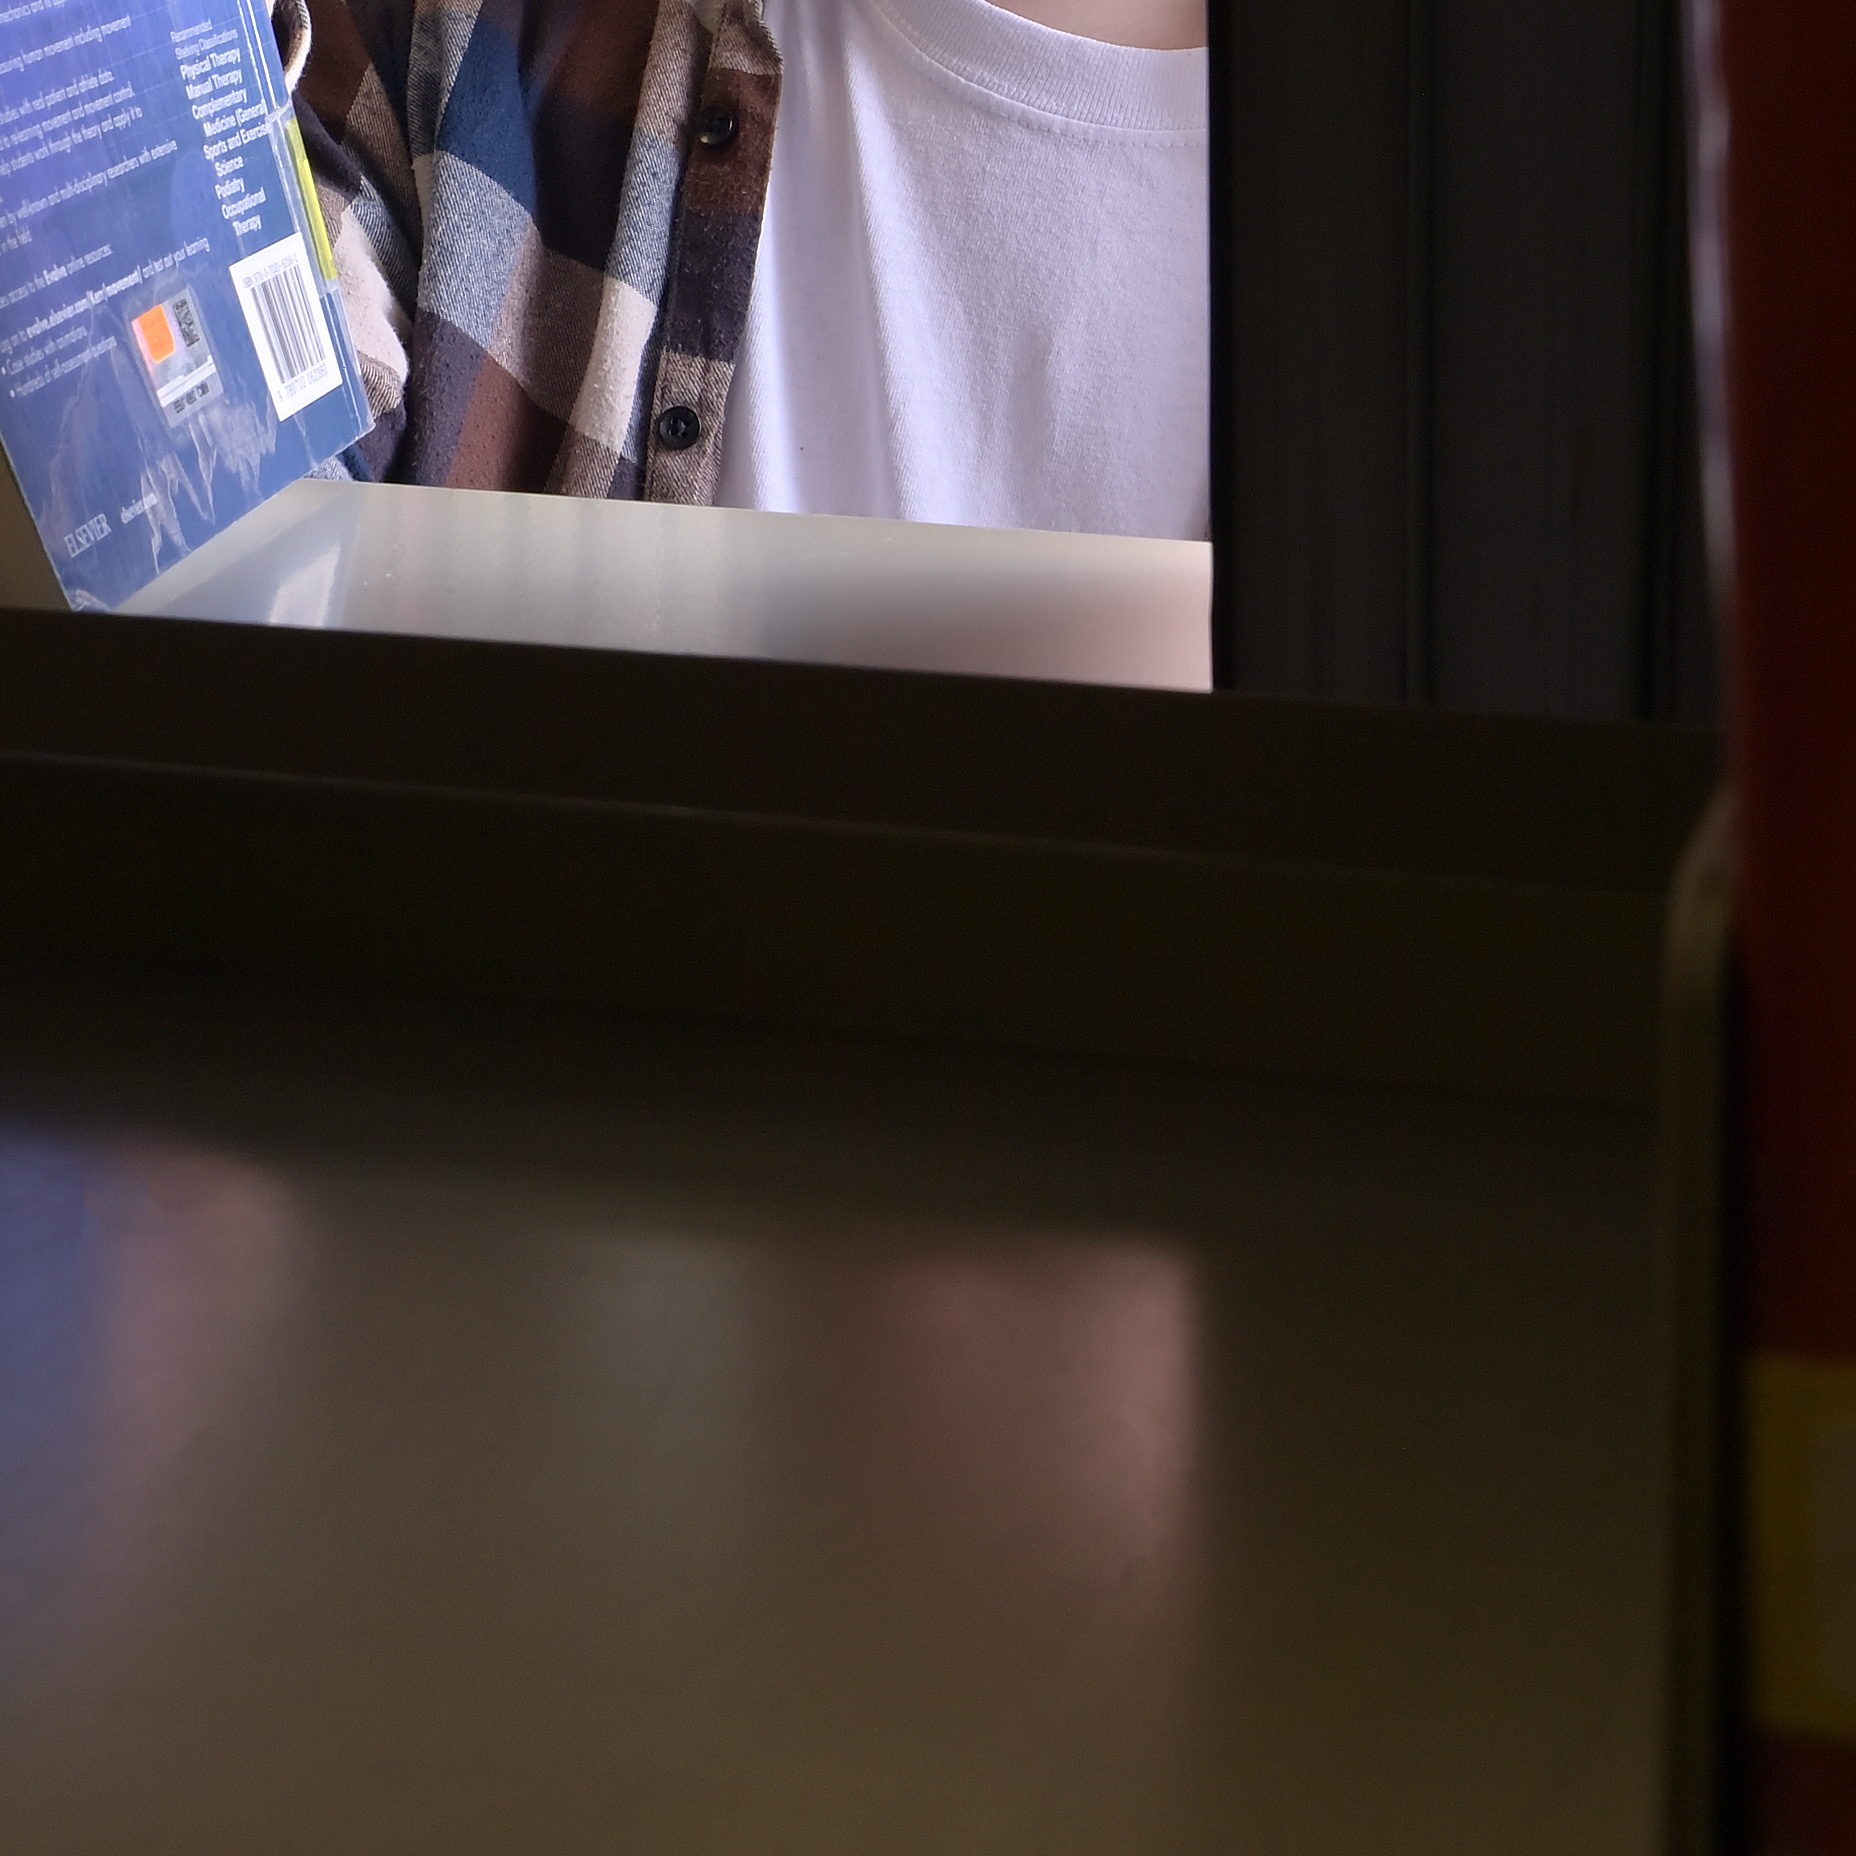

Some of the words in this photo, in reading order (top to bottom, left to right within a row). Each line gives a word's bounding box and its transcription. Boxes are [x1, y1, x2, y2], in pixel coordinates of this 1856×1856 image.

[180, 56, 211, 82] Physical
[210, 44, 241, 71] Therapy
[186, 77, 213, 100] Manual
[212, 65, 243, 92] Therapy
[193, 85, 247, 123] Complementary
[203, 111, 236, 137] Medicine
[203, 137, 228, 162] Sports
[226, 131, 242, 150] and
[215, 152, 243, 177] Science
[215, 174, 245, 202] Podiatry
[222, 187, 265, 222] Occupational
[233, 211, 262, 240] Therapy
[64, 513, 111, 557] ELSEVIER
